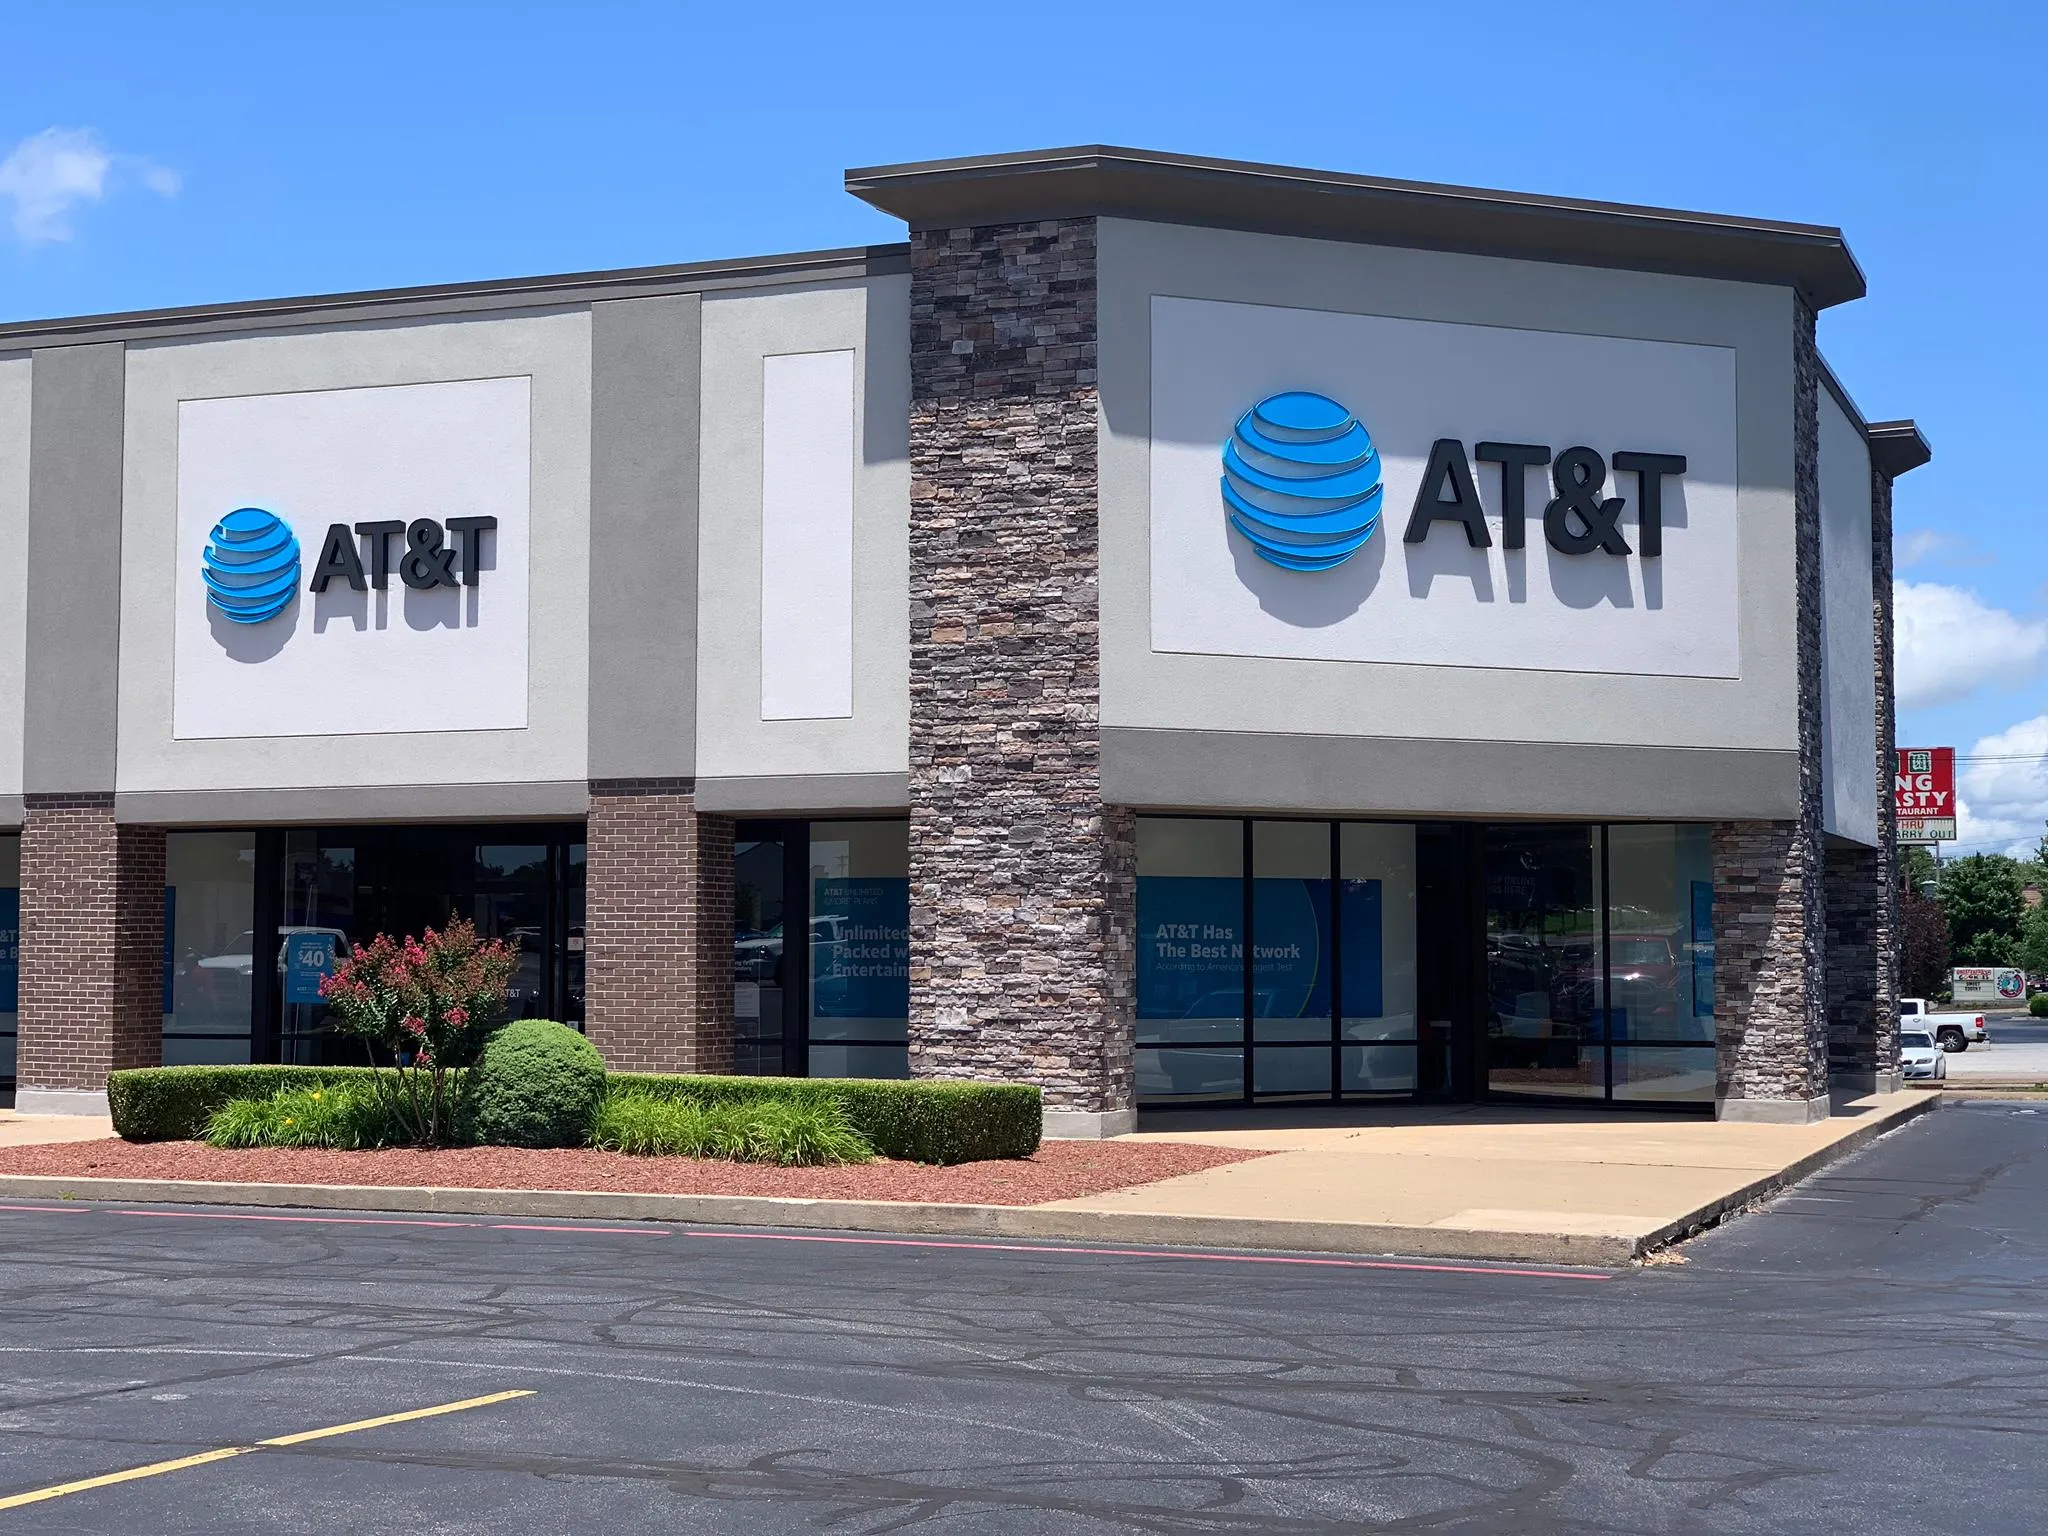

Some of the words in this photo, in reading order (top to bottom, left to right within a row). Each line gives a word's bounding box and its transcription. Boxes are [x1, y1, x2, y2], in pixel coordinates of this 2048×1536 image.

[1403, 439, 1687, 557] AT&T
[310, 516, 498, 592] AT&T
[1930, 830, 1952, 838] OUT
[1156, 924, 1199, 939] AT&T
[1203, 924, 1233, 939] Has
[833, 943, 890, 959] Packed
[1156, 943, 1187, 958] The
[1191, 943, 1228, 958] Best
[1231, 943, 1300, 958] Ntwork
[297, 950, 324, 967] $40
[1156, 962, 1195, 973] According
[1196, 962, 1205, 971] to
[499, 988, 520, 998] AT&T
